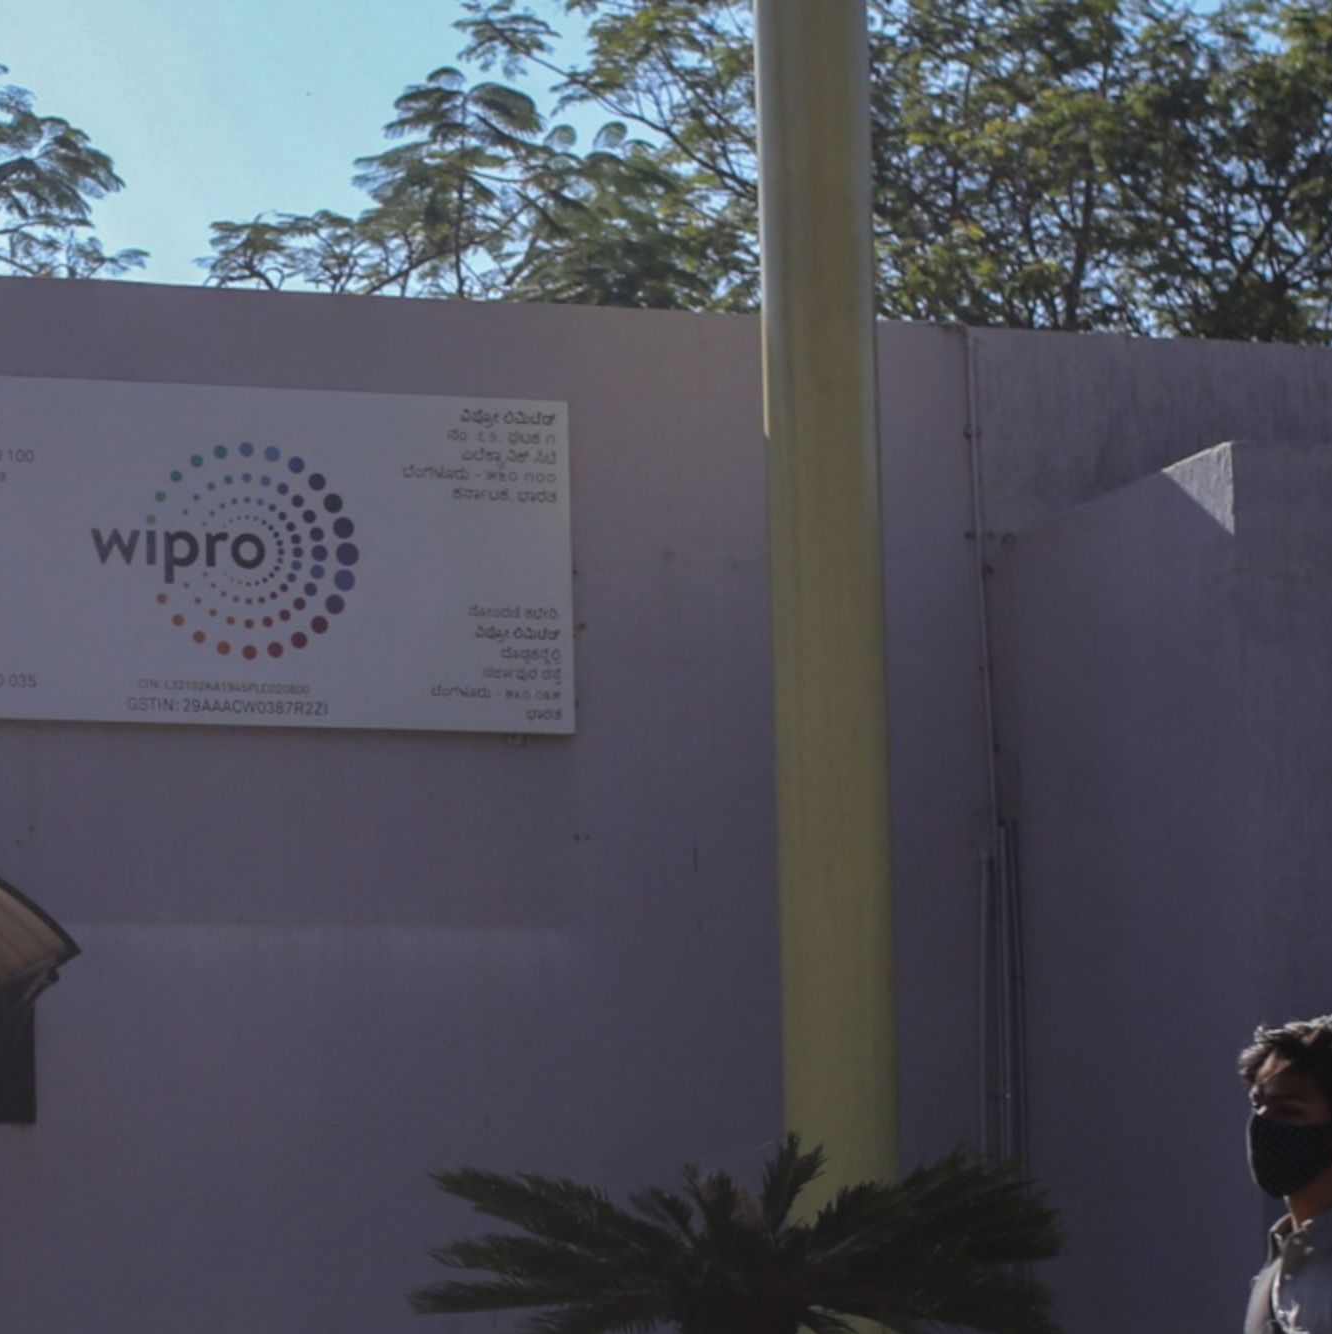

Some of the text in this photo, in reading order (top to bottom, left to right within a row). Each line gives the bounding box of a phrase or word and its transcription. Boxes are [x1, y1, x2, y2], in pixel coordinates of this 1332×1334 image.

[460, 408, 556, 428] ವಿಪ್ರೋ ಲಿಮಿಟೆಡ್
[8, 449, 35, 463] 100
[90, 528, 266, 584] wipro
[8, 674, 37, 688] 035
[126, 698, 179, 711] GSTIN:
